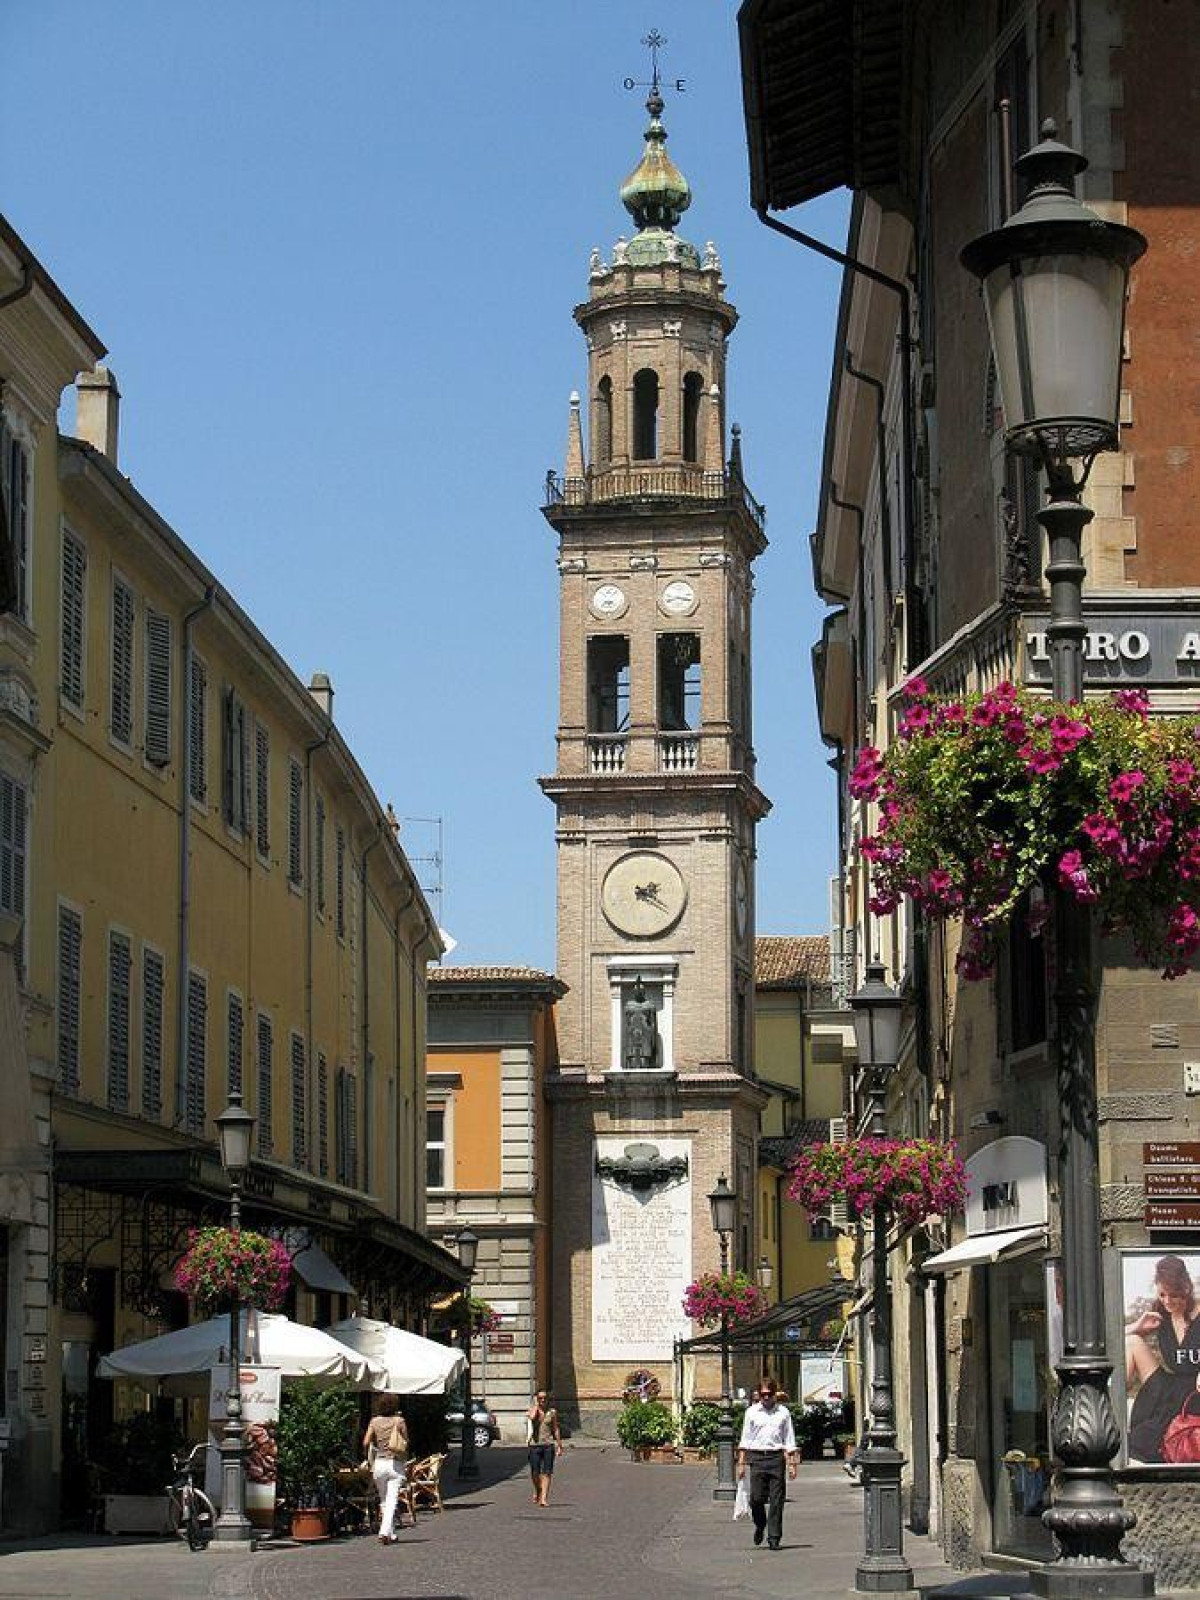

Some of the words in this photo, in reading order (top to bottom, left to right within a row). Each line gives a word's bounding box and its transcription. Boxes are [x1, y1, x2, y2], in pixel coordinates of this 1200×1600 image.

[624, 78, 635, 90] O
[676, 79, 686, 91] E
[1027, 630, 1150, 661] TRO
